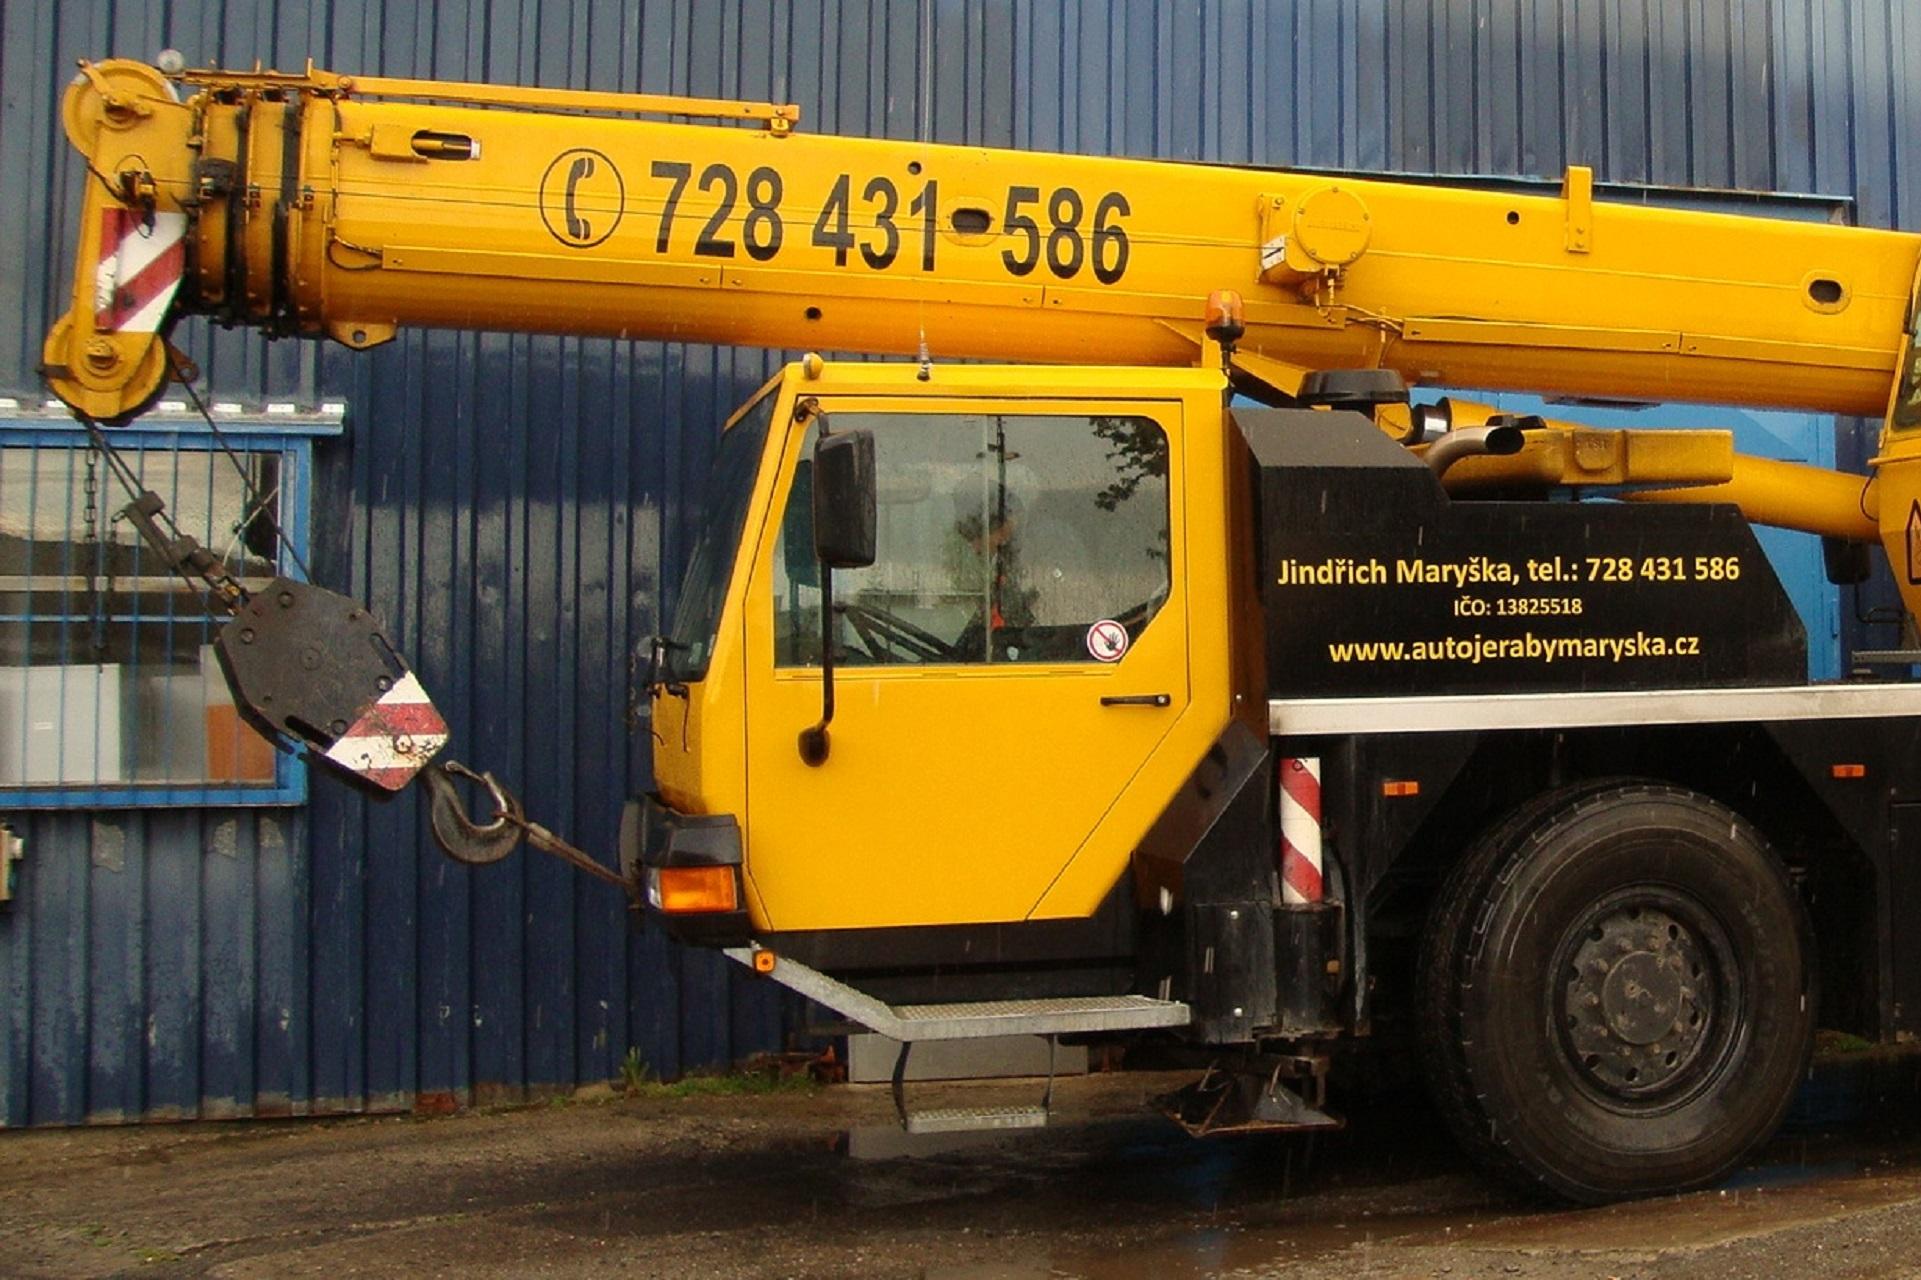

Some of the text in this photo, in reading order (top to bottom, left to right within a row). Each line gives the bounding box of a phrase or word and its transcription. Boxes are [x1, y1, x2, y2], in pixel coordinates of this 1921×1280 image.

[651, 161, 1131, 285] 728 431 586
[1277, 556, 1740, 588] Jindřich Maryška, tel.: 728 431 586
[1454, 595, 1583, 616] IČO: 13825518
[1328, 631, 1701, 664] www.autojerabymaryska.cz
